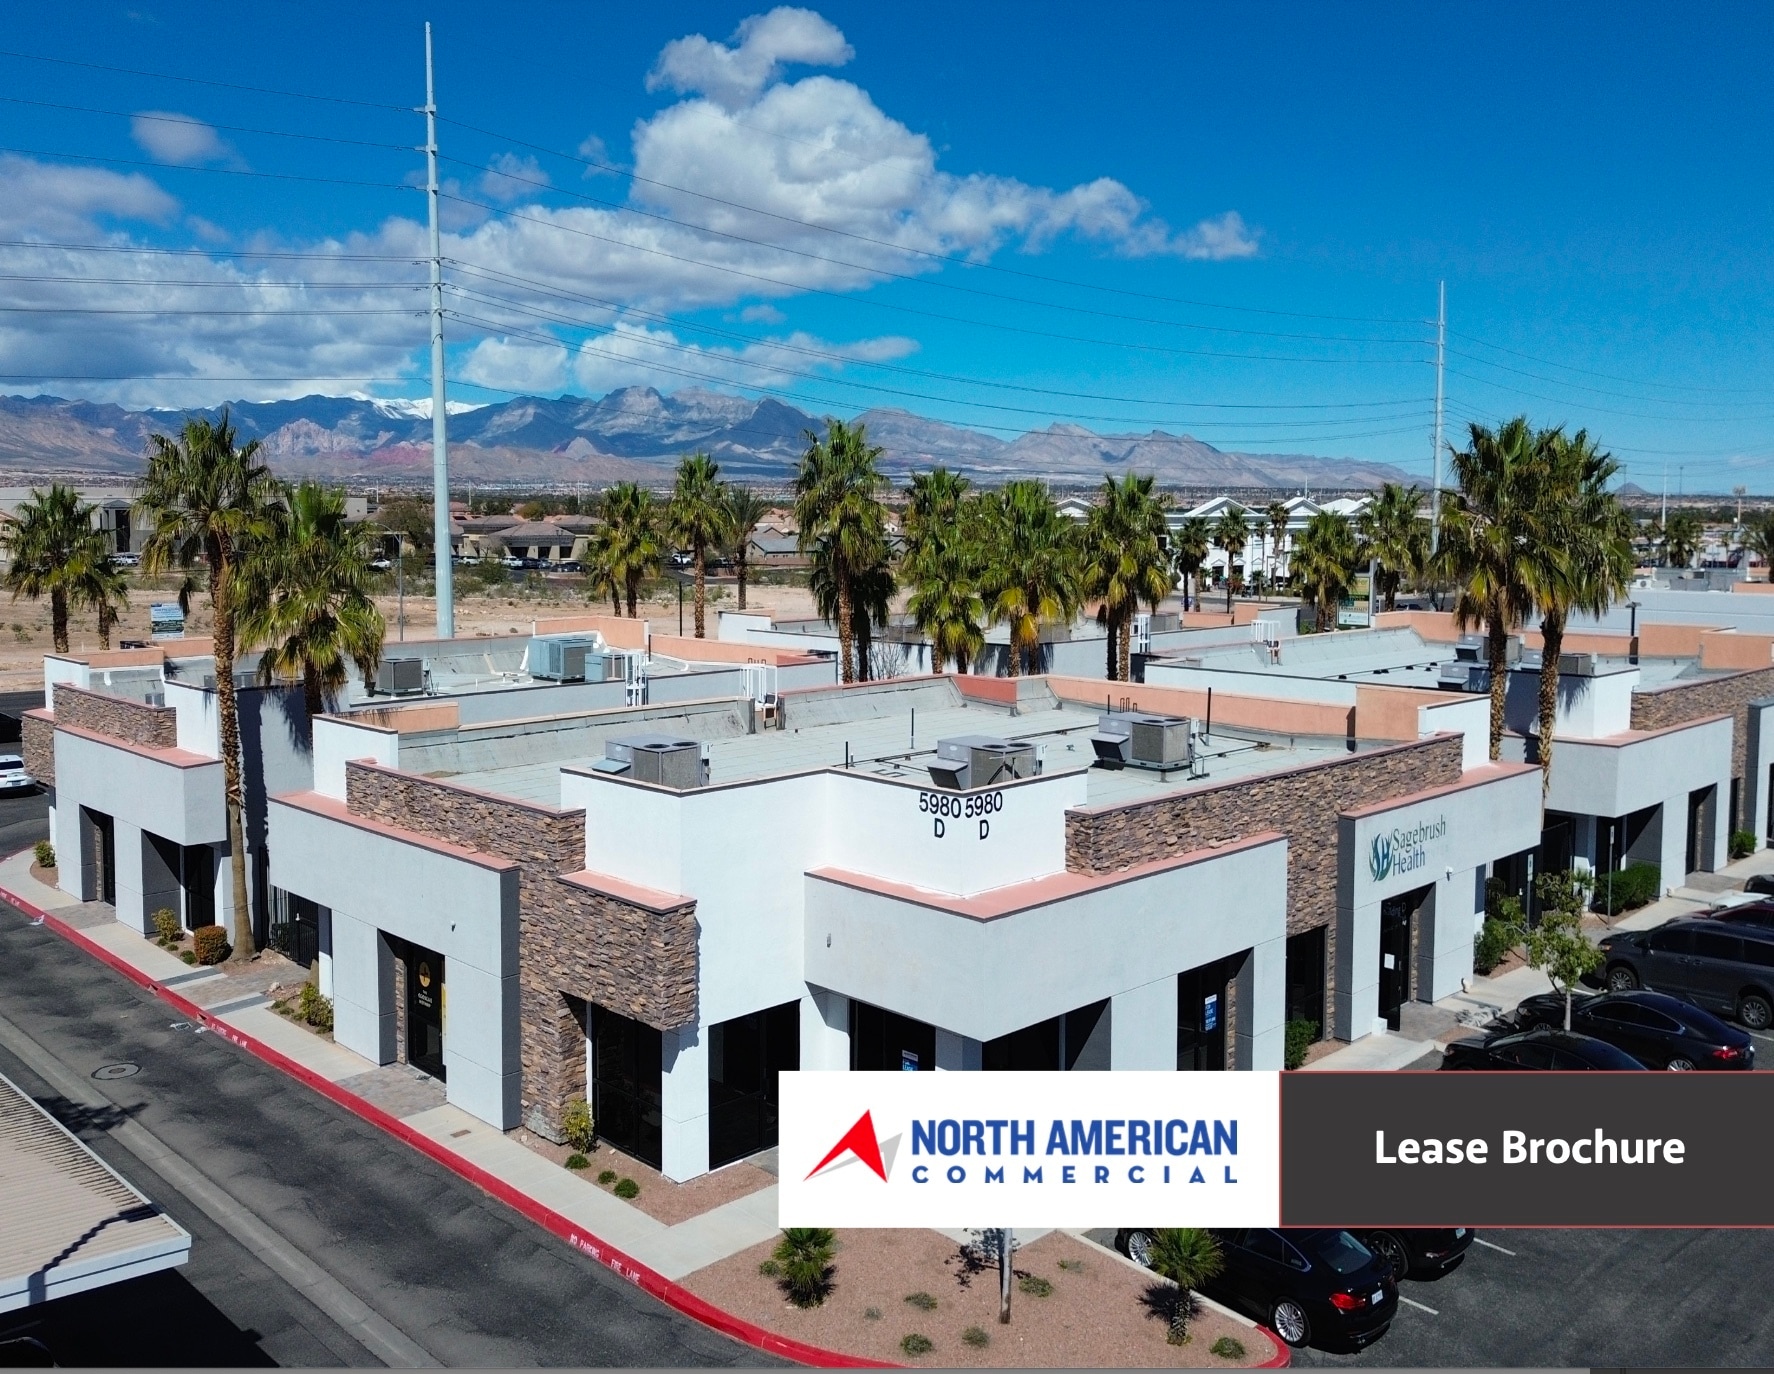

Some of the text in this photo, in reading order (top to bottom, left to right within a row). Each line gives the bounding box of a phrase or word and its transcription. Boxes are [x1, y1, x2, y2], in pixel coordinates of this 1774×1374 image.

[919, 792, 961, 818] 5980
[965, 792, 1003, 818] 5980
[934, 818, 945, 838] D
[980, 819, 989, 840] D
[1393, 814, 1446, 853] Sagebrush
[1393, 845, 1426, 876] Health
[580, 1239, 600, 1259] PARKING
[611, 1259, 622, 1273] FIRE
[626, 1268, 640, 1284] LANE
